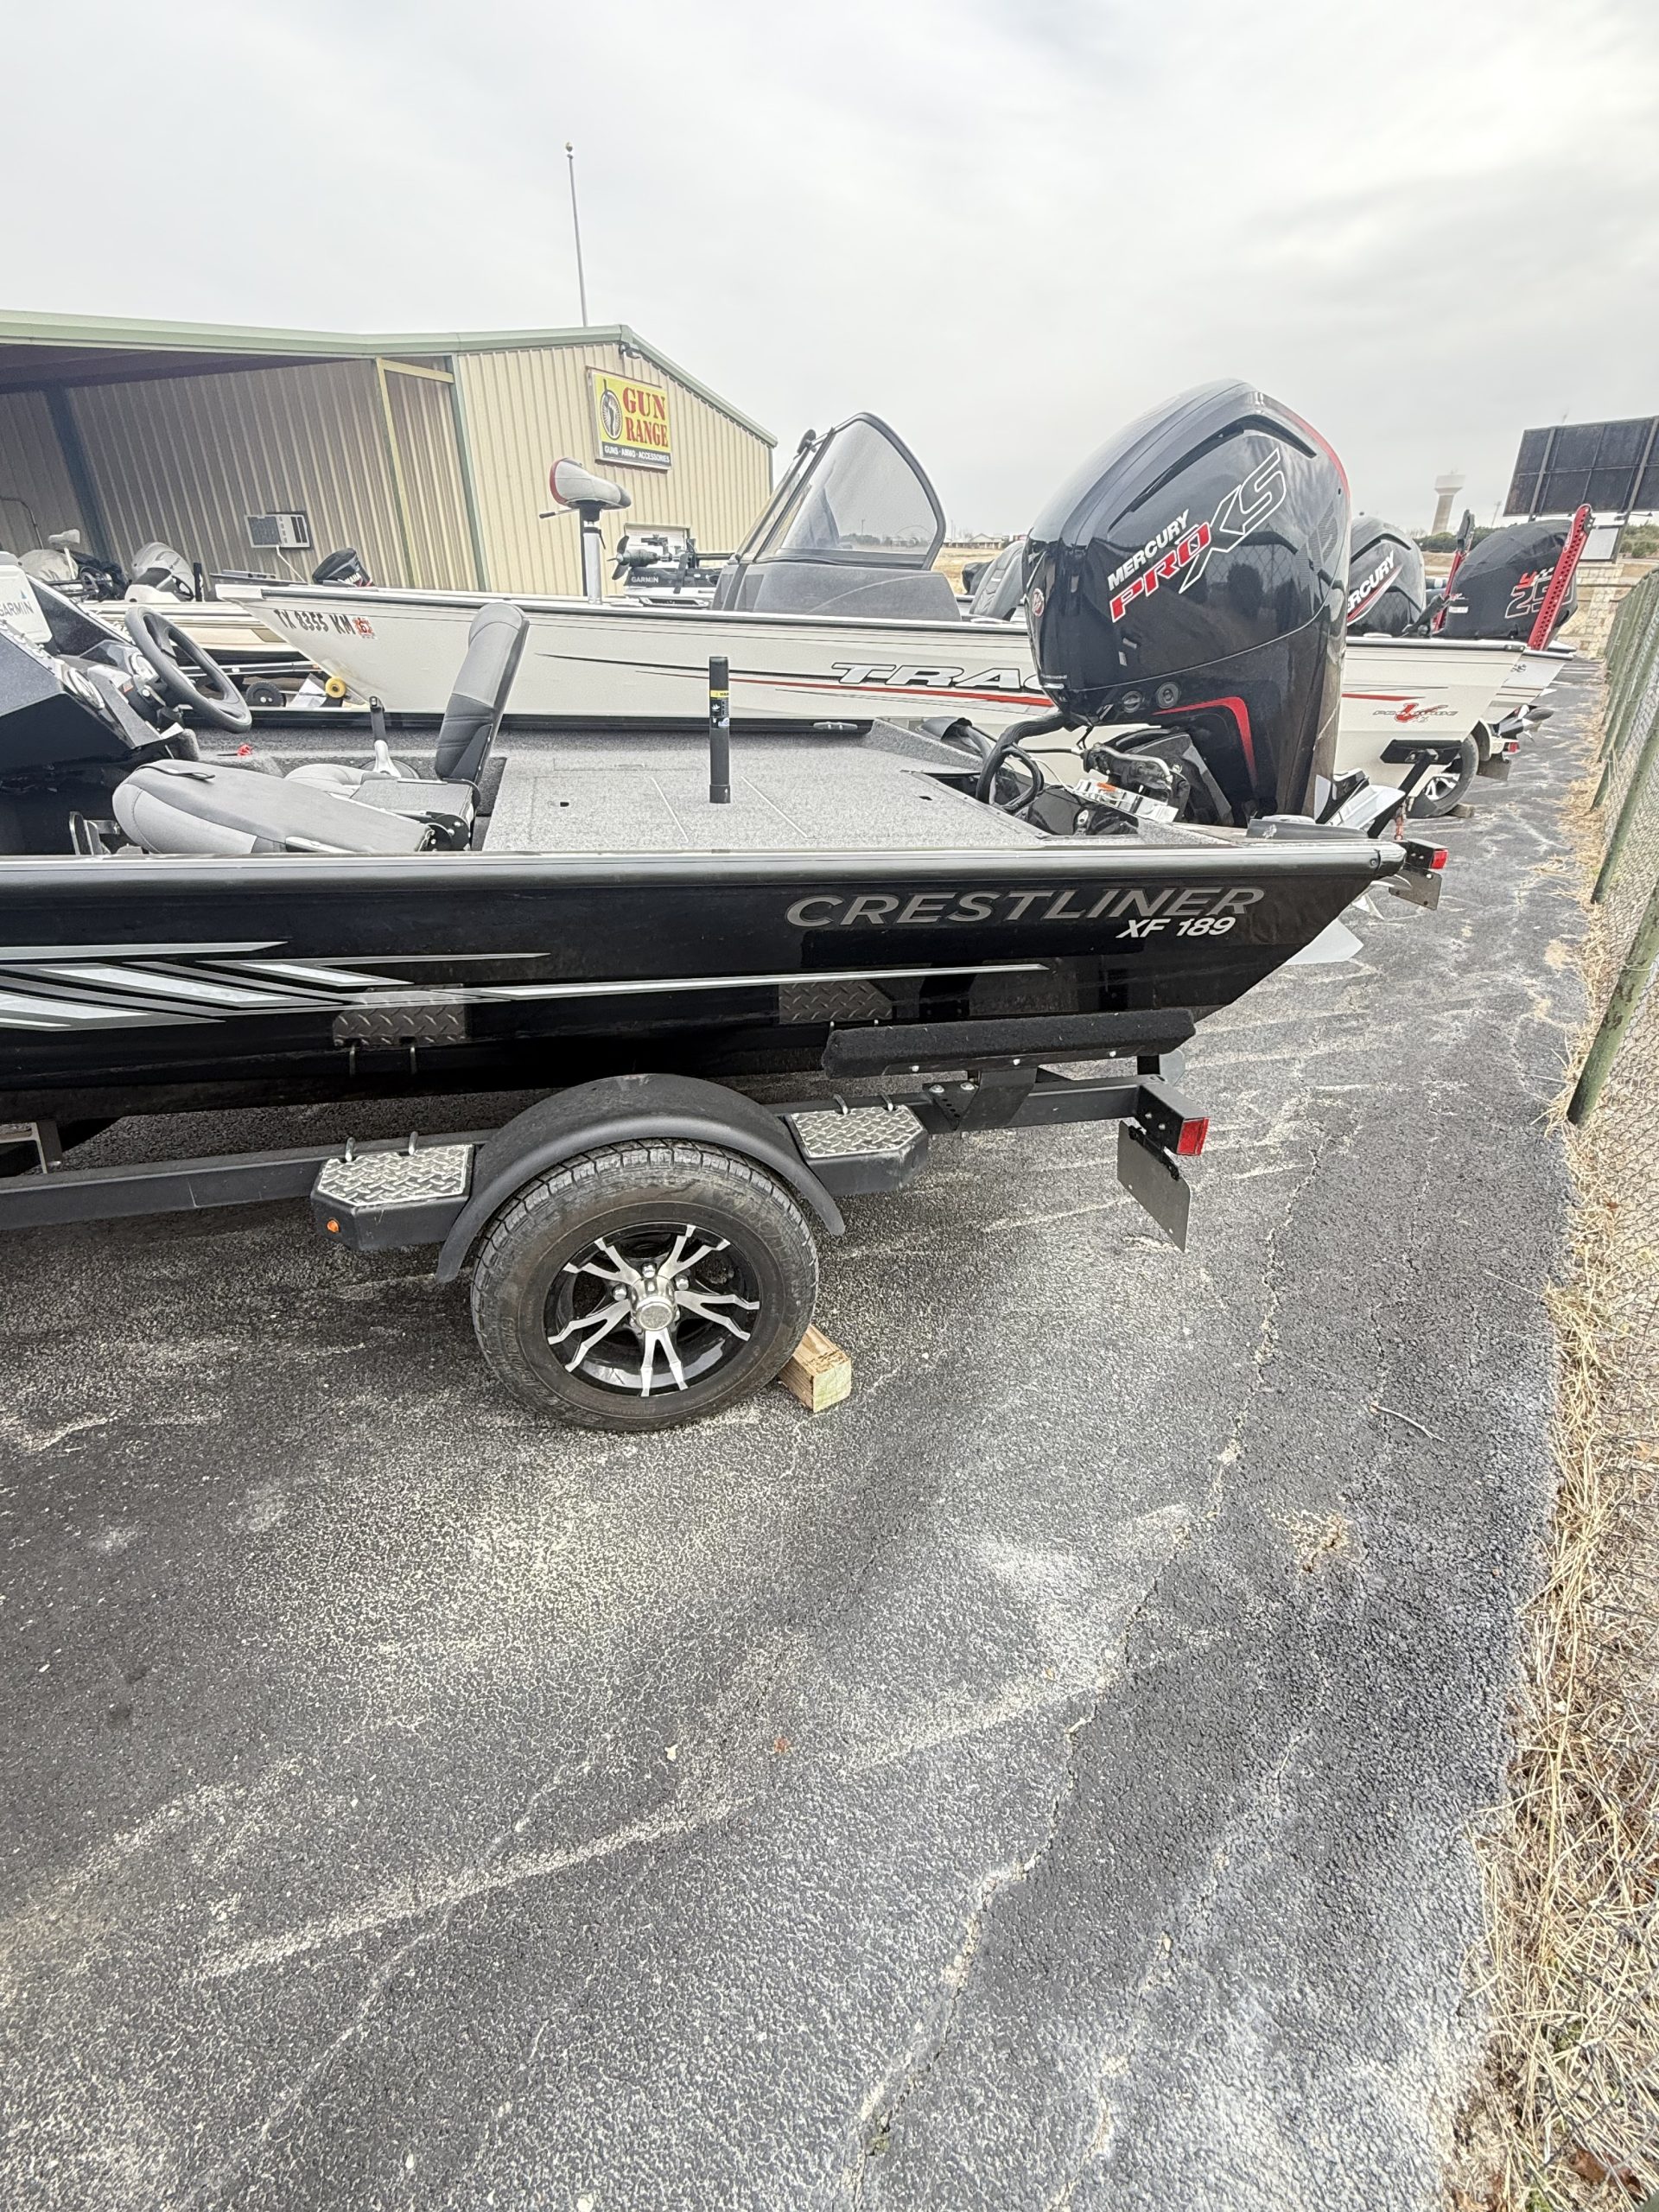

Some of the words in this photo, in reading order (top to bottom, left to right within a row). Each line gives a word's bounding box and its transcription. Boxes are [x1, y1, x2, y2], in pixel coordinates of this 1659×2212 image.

[622, 386, 665, 421] GUN
[626, 416, 669, 448] RANGE
[605, 445, 619, 455] GUNS
[622, 448, 636, 458] AMMO
[639, 450, 670, 463] ACCESSORIES
[1107, 508, 1189, 591] MERCURY
[1109, 521, 1211, 623] PRO
[1178, 447, 1287, 594] XS
[273, 609, 297, 629] TX
[294, 610, 329, 632] 8355
[328, 613, 357, 635] KM
[785, 887, 1265, 928] CRESTLINER
[1115, 917, 1171, 939] XF
[1175, 916, 1237, 938] 189
